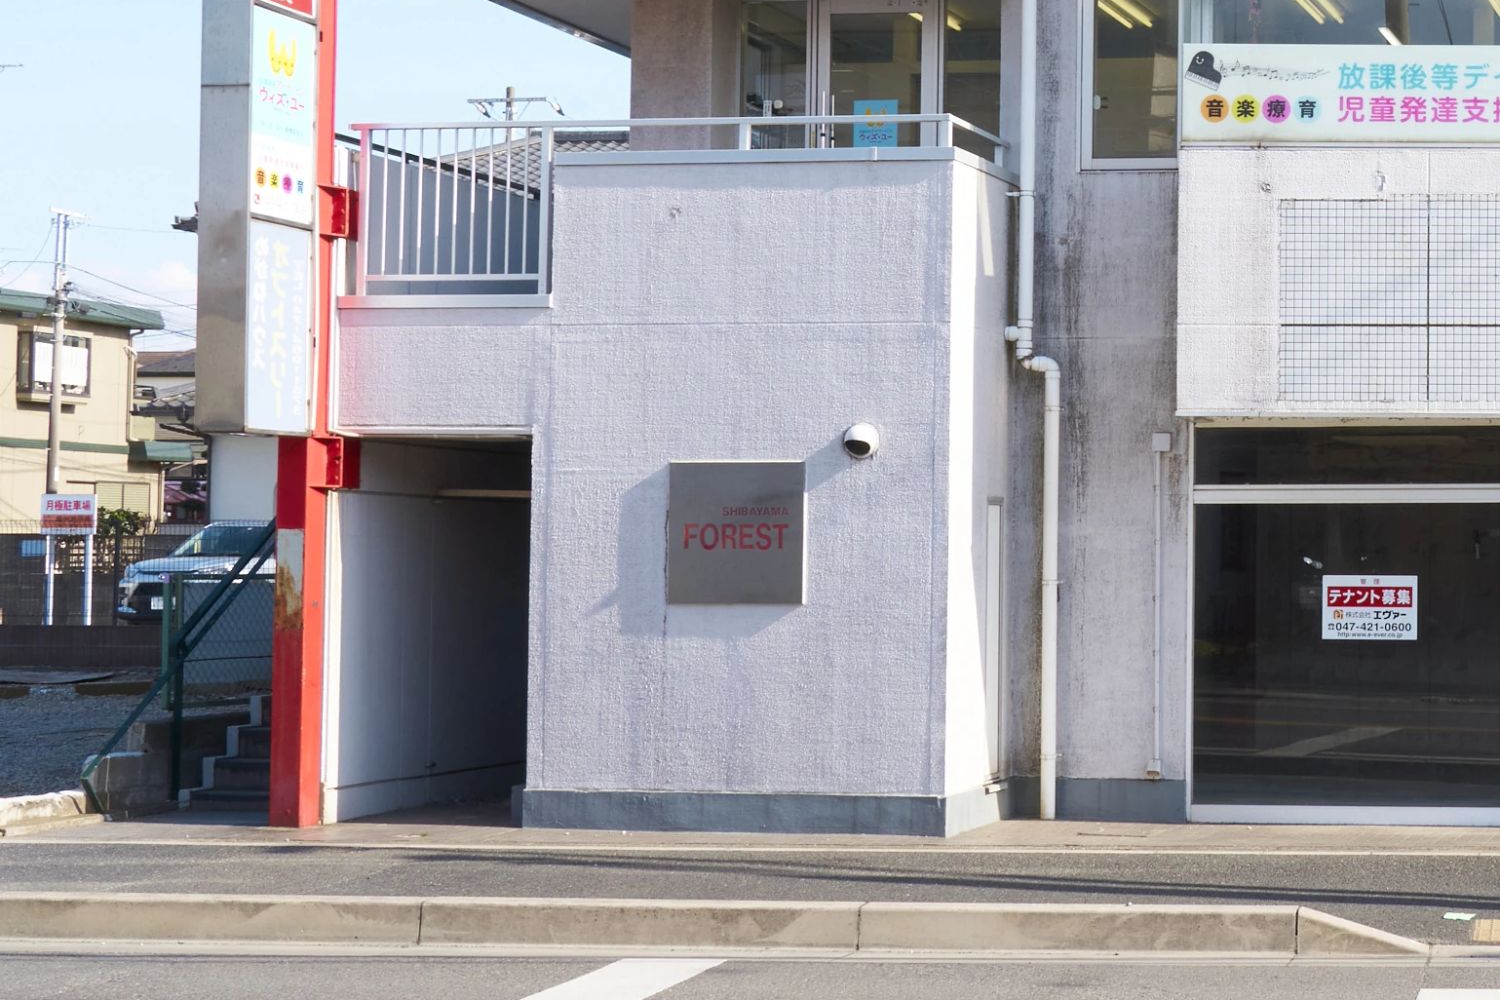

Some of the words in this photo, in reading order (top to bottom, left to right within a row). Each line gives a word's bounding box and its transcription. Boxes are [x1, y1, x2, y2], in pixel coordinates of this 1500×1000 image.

[1206, 99, 1316, 118] 音楽療育
[46, 500, 91, 511] 月極駐車場
[722, 506, 789, 517] SHIBAYAMA
[683, 523, 789, 551] FOREST
[1329, 589, 1411, 605] テナント募集
[1373, 610, 1407, 620] エヴァー
[1335, 622, 1412, 632] 047-421-0600
